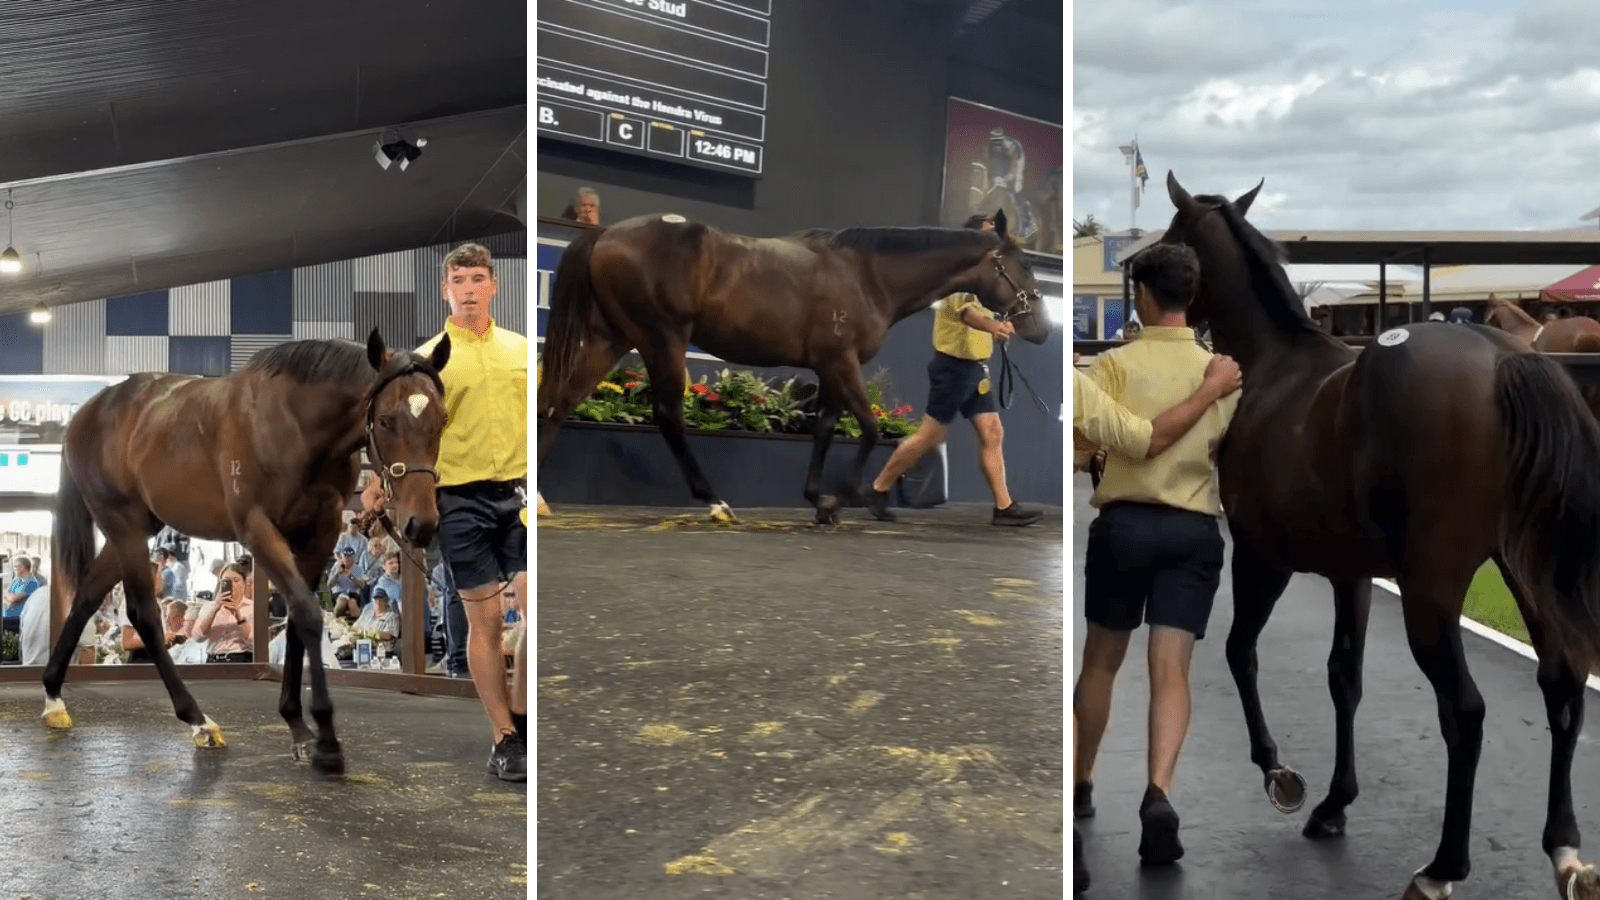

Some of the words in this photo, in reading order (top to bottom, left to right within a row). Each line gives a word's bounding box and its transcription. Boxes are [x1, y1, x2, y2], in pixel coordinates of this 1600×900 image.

[648, 0, 687, 18] Stud
[539, 106, 559, 125] B.
[586, 88, 630, 105] against
[632, 96, 651, 109] the
[694, 109, 723, 125] Virus
[618, 123, 633, 140] C
[695, 139, 731, 159] 12:46
[733, 147, 756, 164] PM
[230, 459, 241, 475] 12
